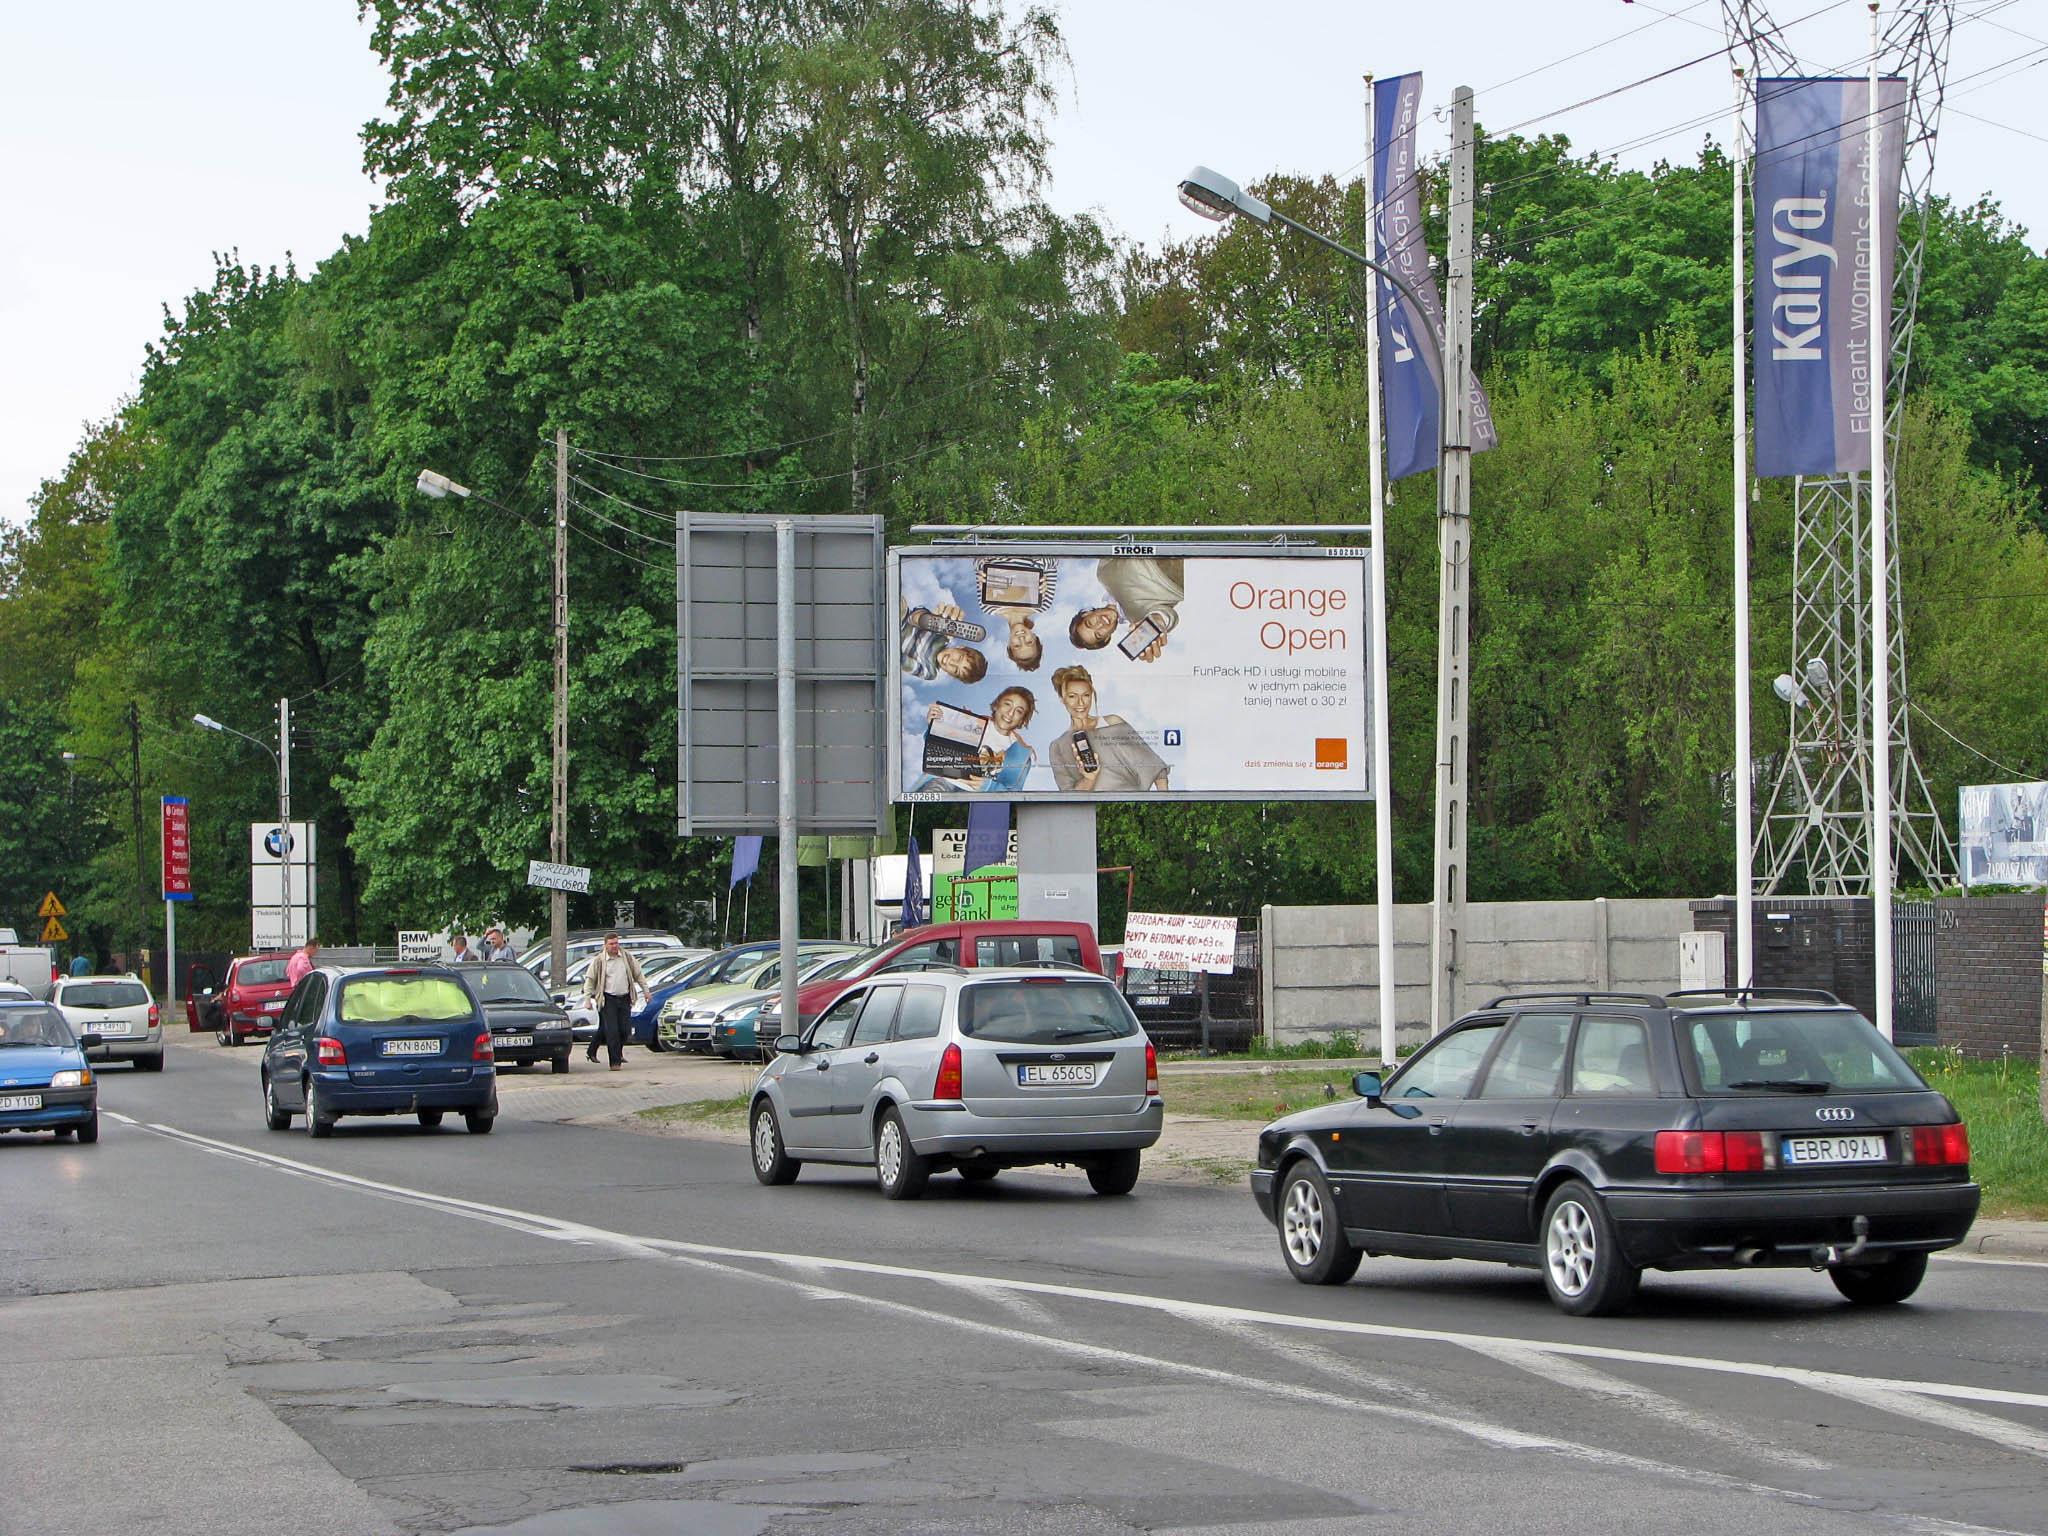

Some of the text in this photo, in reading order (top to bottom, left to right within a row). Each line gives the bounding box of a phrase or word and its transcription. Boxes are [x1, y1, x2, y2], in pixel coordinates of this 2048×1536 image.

[1847, 339, 1871, 433] Elegant
[1114, 545, 1154, 554] STRÖER
[1229, 581, 1347, 617] Orange
[1260, 621, 1346, 657] Open
[1193, 666, 1240, 677] FunPack
[1243, 666, 1261, 677] HD
[1270, 666, 1301, 679] usługi
[1304, 666, 1347, 678] mobilne
[1247, 681, 1347, 695] w jednym pakiecie
[1243, 696, 1347, 707] taniej nawet o 30 zł
[1244, 760, 1261, 768] dziś
[1263, 760, 1294, 768] zmienia
[1295, 760, 1307, 770] się
[1316, 761, 1345, 769] orange
[903, 793, 941, 801] 8502683
[535, 863, 584, 878] SPRZEDAM
[401, 933, 429, 943] BMW
[389, 1040, 438, 1052] PKN 86NS
[1028, 1066, 1092, 1081] EL 656CS
[15, 1096, 41, 1107] Y103
[1793, 1140, 1832, 1160] EBR
